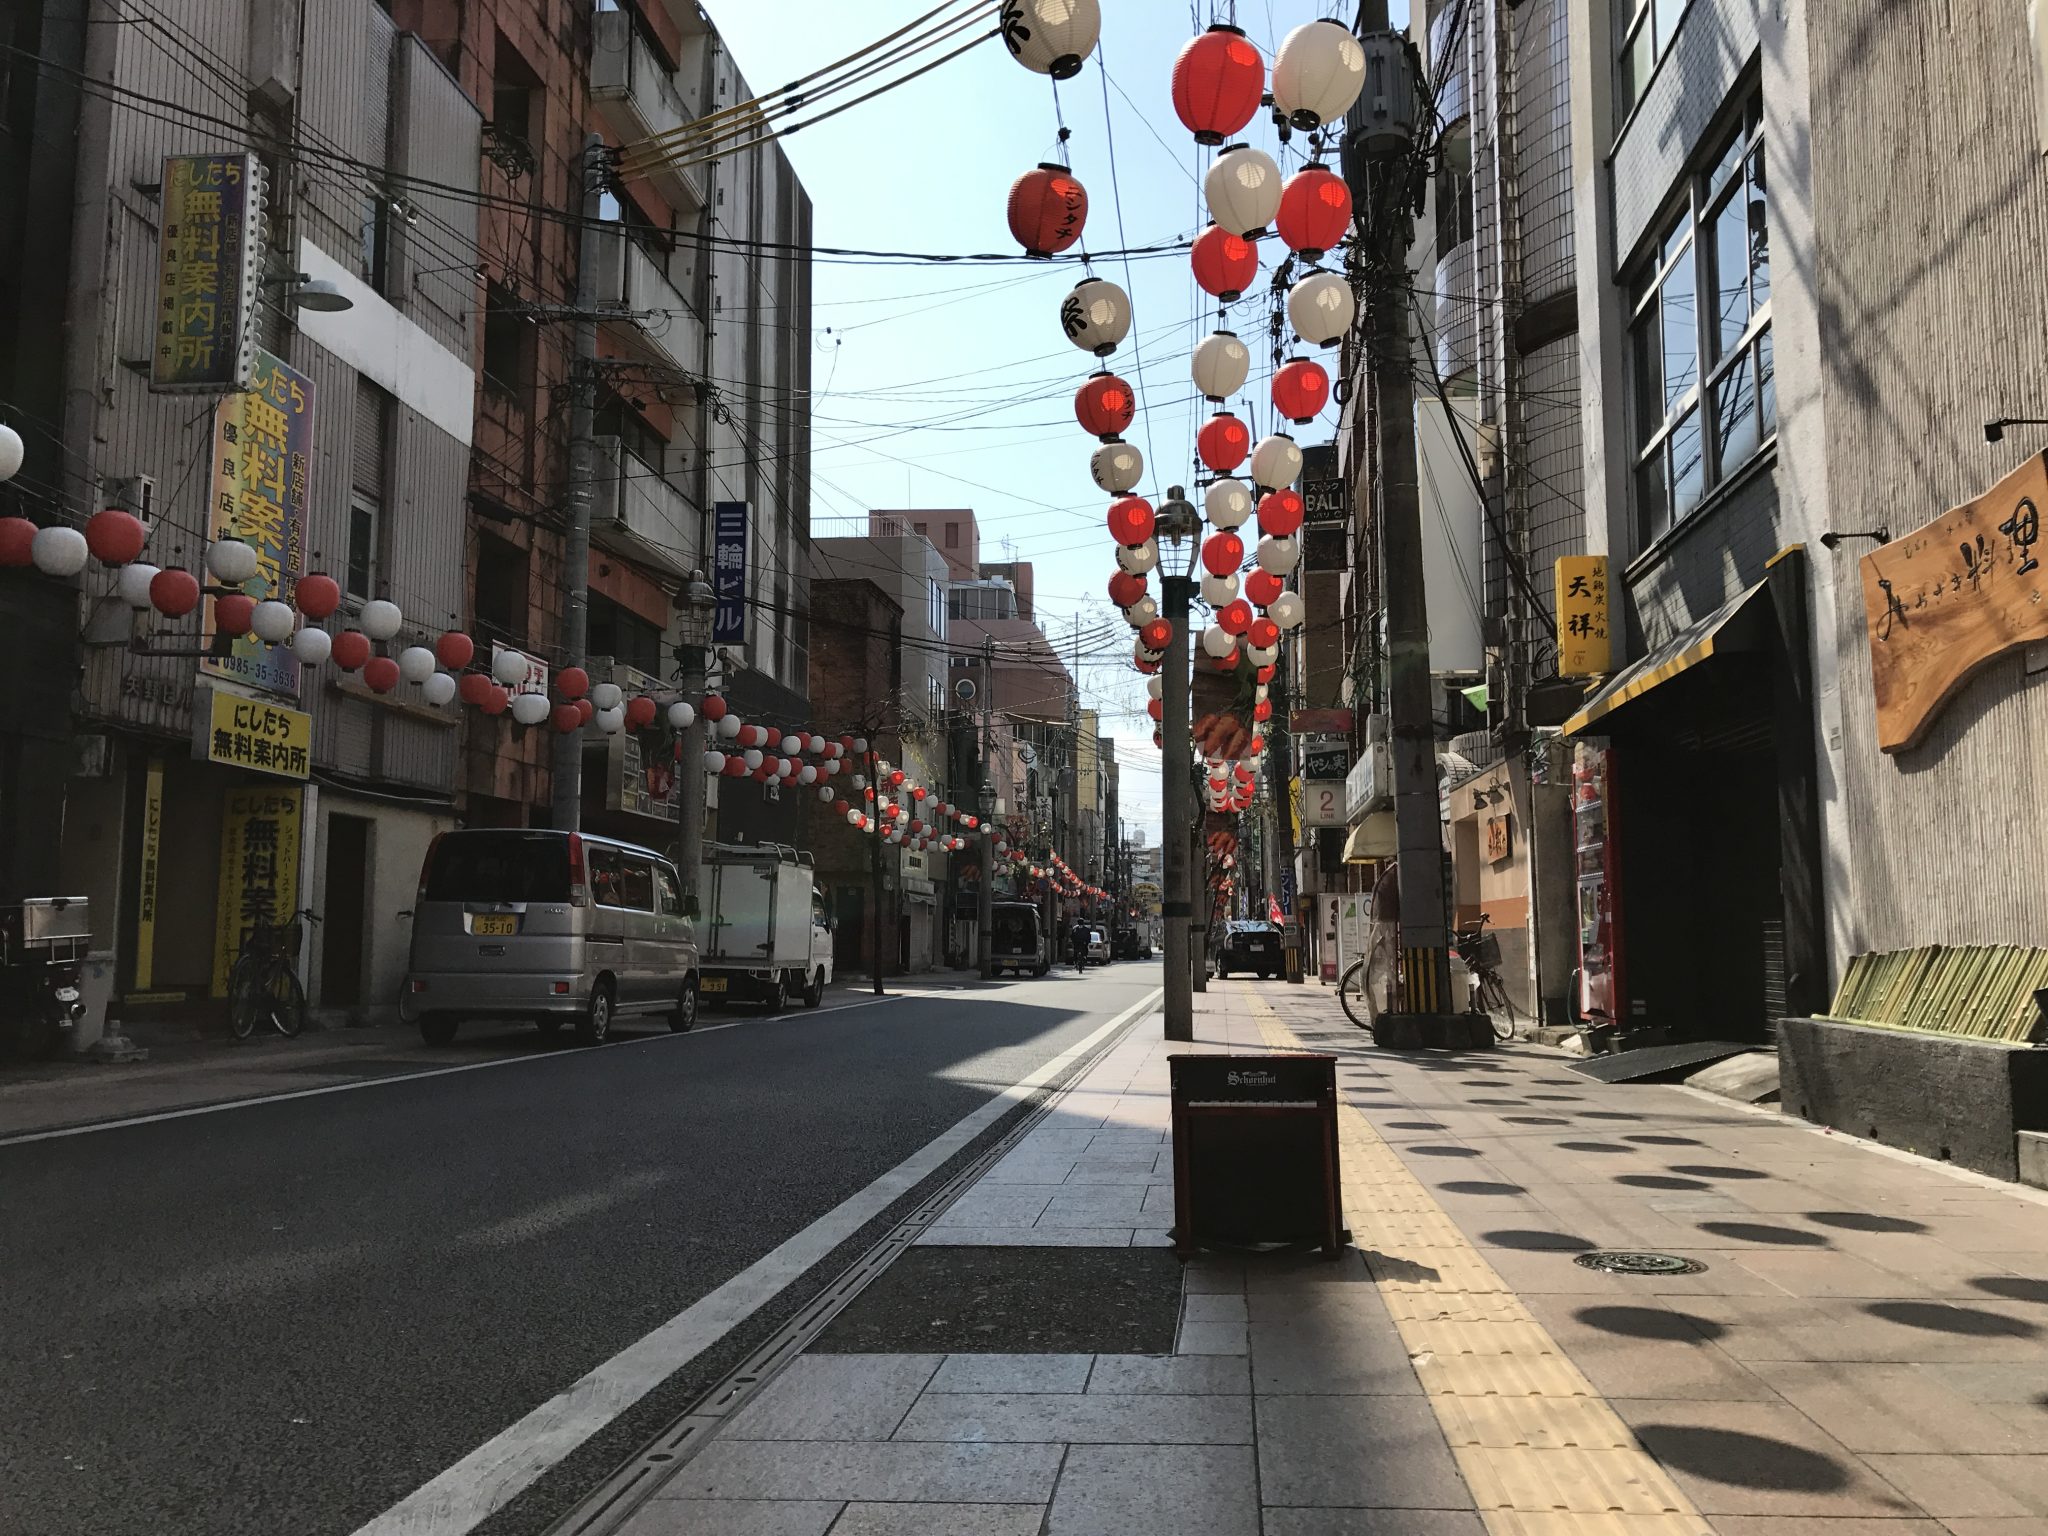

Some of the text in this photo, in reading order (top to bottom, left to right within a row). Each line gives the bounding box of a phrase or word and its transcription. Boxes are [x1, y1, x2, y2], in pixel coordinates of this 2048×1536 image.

[170, 161, 241, 187] にしたち
[175, 189, 223, 370] 無料案内所
[1305, 492, 1344, 512] BALI
[717, 512, 744, 632] 三輪ビル
[1568, 576, 1595, 640] 天祥
[223, 657, 296, 690] 0985-35-3636
[234, 704, 291, 739] にしたち
[213, 728, 306, 774] 無料案内所
[1320, 790, 1335, 812] 2
[482, 922, 513, 935] 35-10
